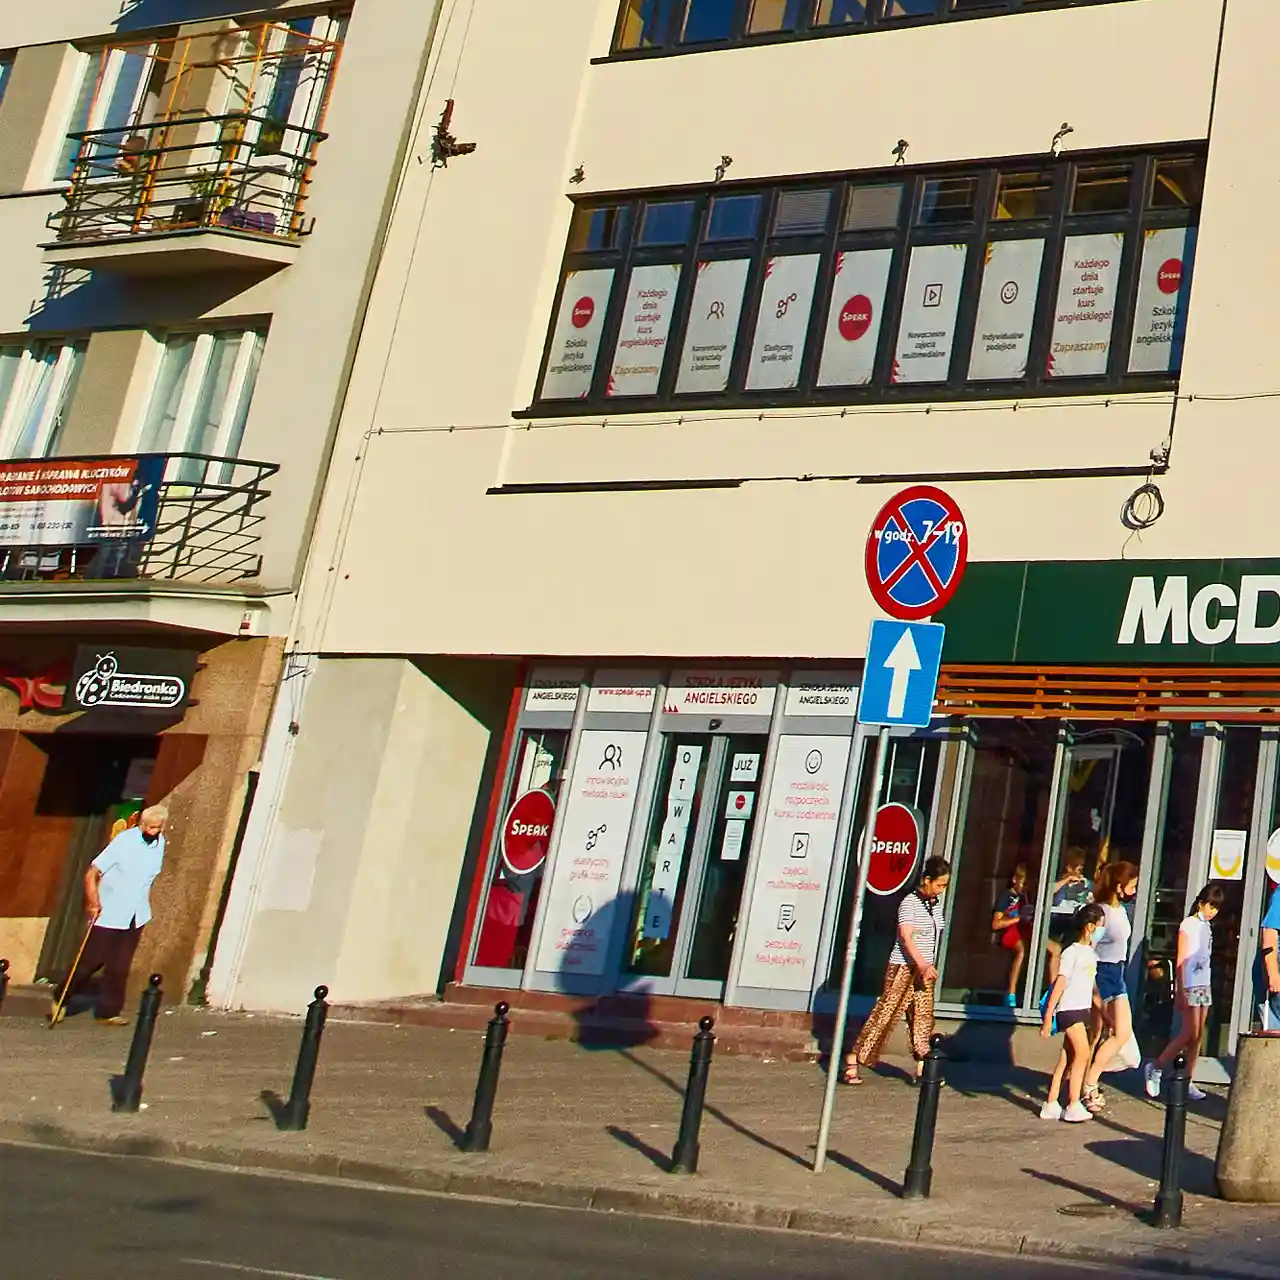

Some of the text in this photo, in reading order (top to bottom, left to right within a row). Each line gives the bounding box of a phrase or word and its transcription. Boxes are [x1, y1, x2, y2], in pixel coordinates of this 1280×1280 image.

[1074, 258, 1110, 270] Każdego
[1080, 271, 1099, 282] dnia
[1072, 285, 1104, 297] startuje
[1077, 298, 1096, 308] kurs
[842, 312, 869, 322] SPEAK
[1153, 306, 1177, 316] Szkoł
[1053, 341, 1109, 355] Zapraszamy
[111, 679, 178, 695] Biedronka
[532, 691, 577, 701] ANGIELSKIEGO
[684, 692, 758, 705] ANGIELSKIEGO
[798, 696, 850, 705] ANGIELSKIEGO
[735, 758, 754, 771] JUŻ
[511, 819, 549, 837] SPEAK
